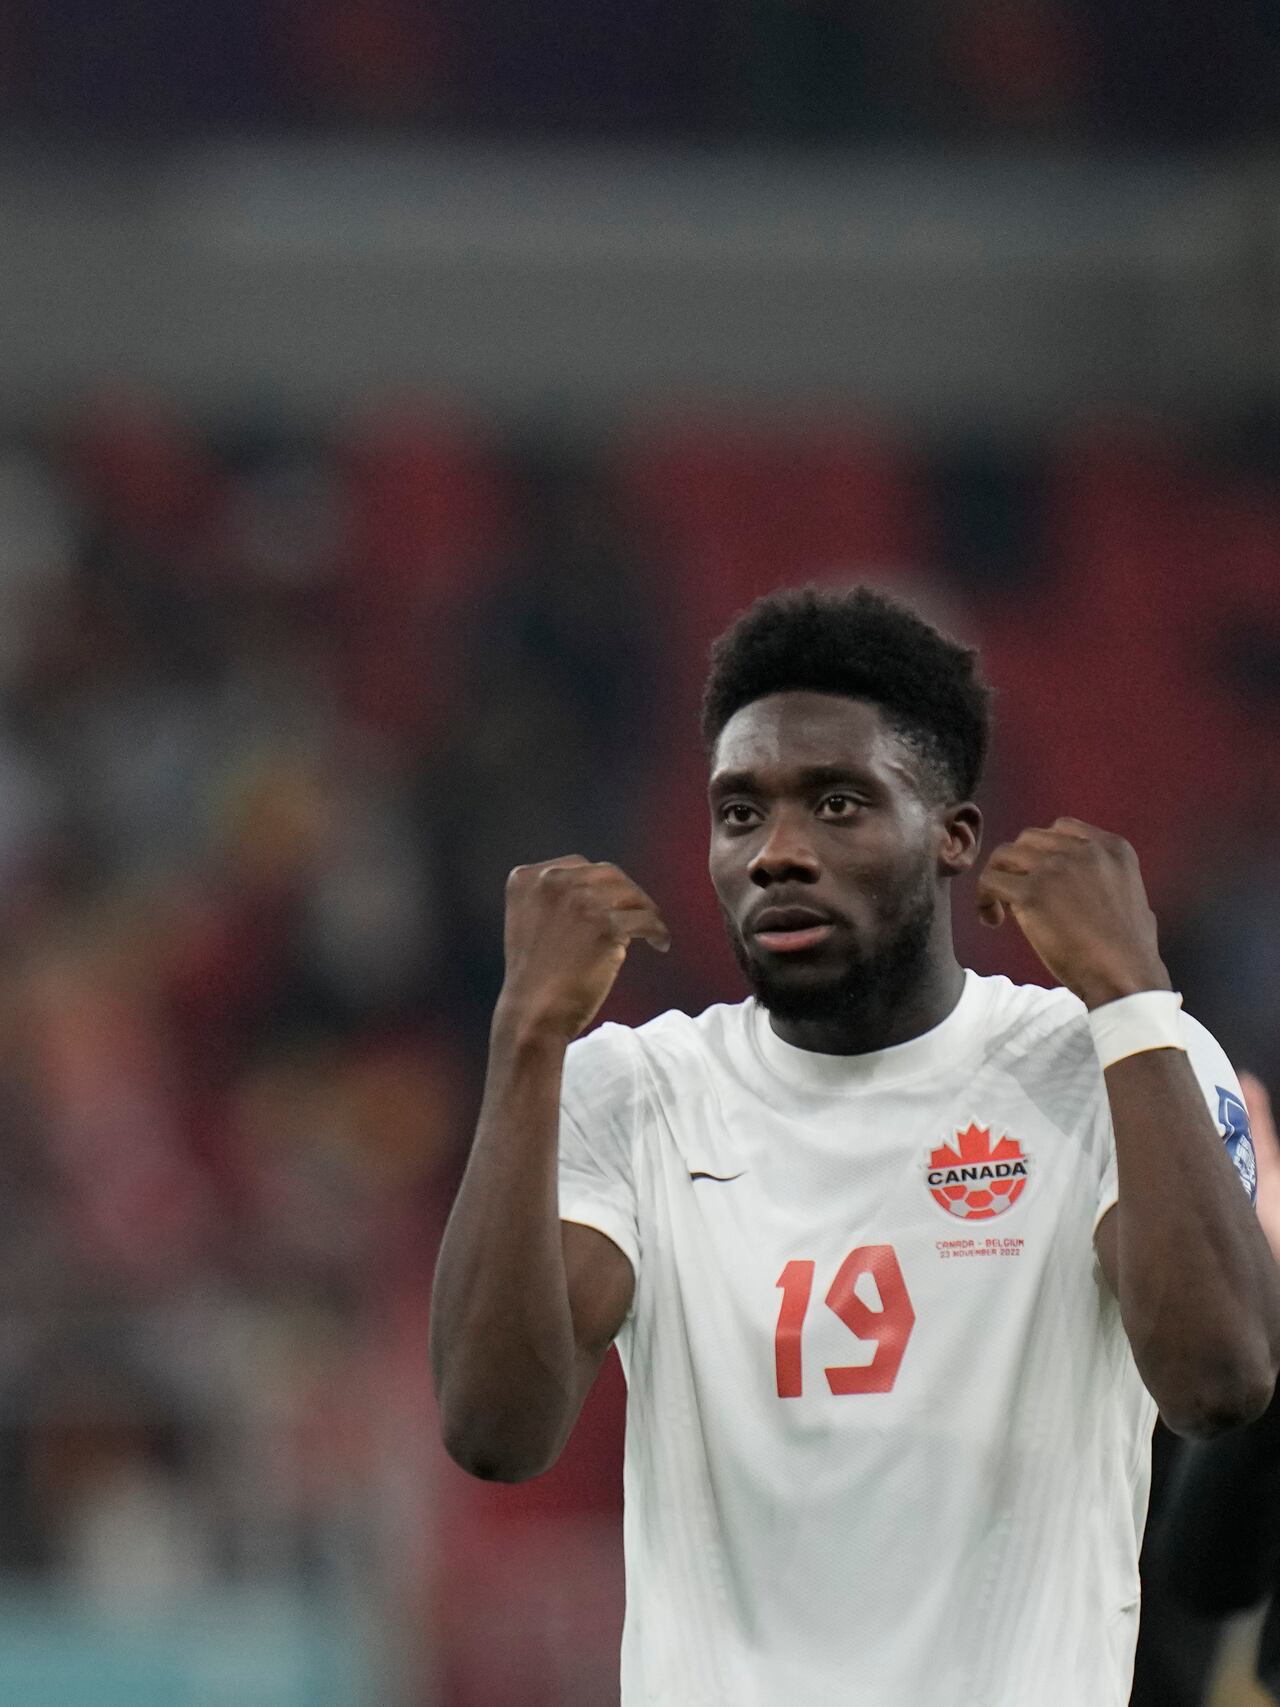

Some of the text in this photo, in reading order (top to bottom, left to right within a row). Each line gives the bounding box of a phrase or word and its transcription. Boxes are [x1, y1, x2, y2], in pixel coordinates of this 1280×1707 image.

[928, 1162, 1027, 1185] CANADA
[936, 1240, 974, 1250] CANADA
[985, 1238, 1025, 1248] BELGIUM
[940, 1248, 1020, 1259] 23 NOVEMBER 2022
[775, 1244, 916, 1399] 19
